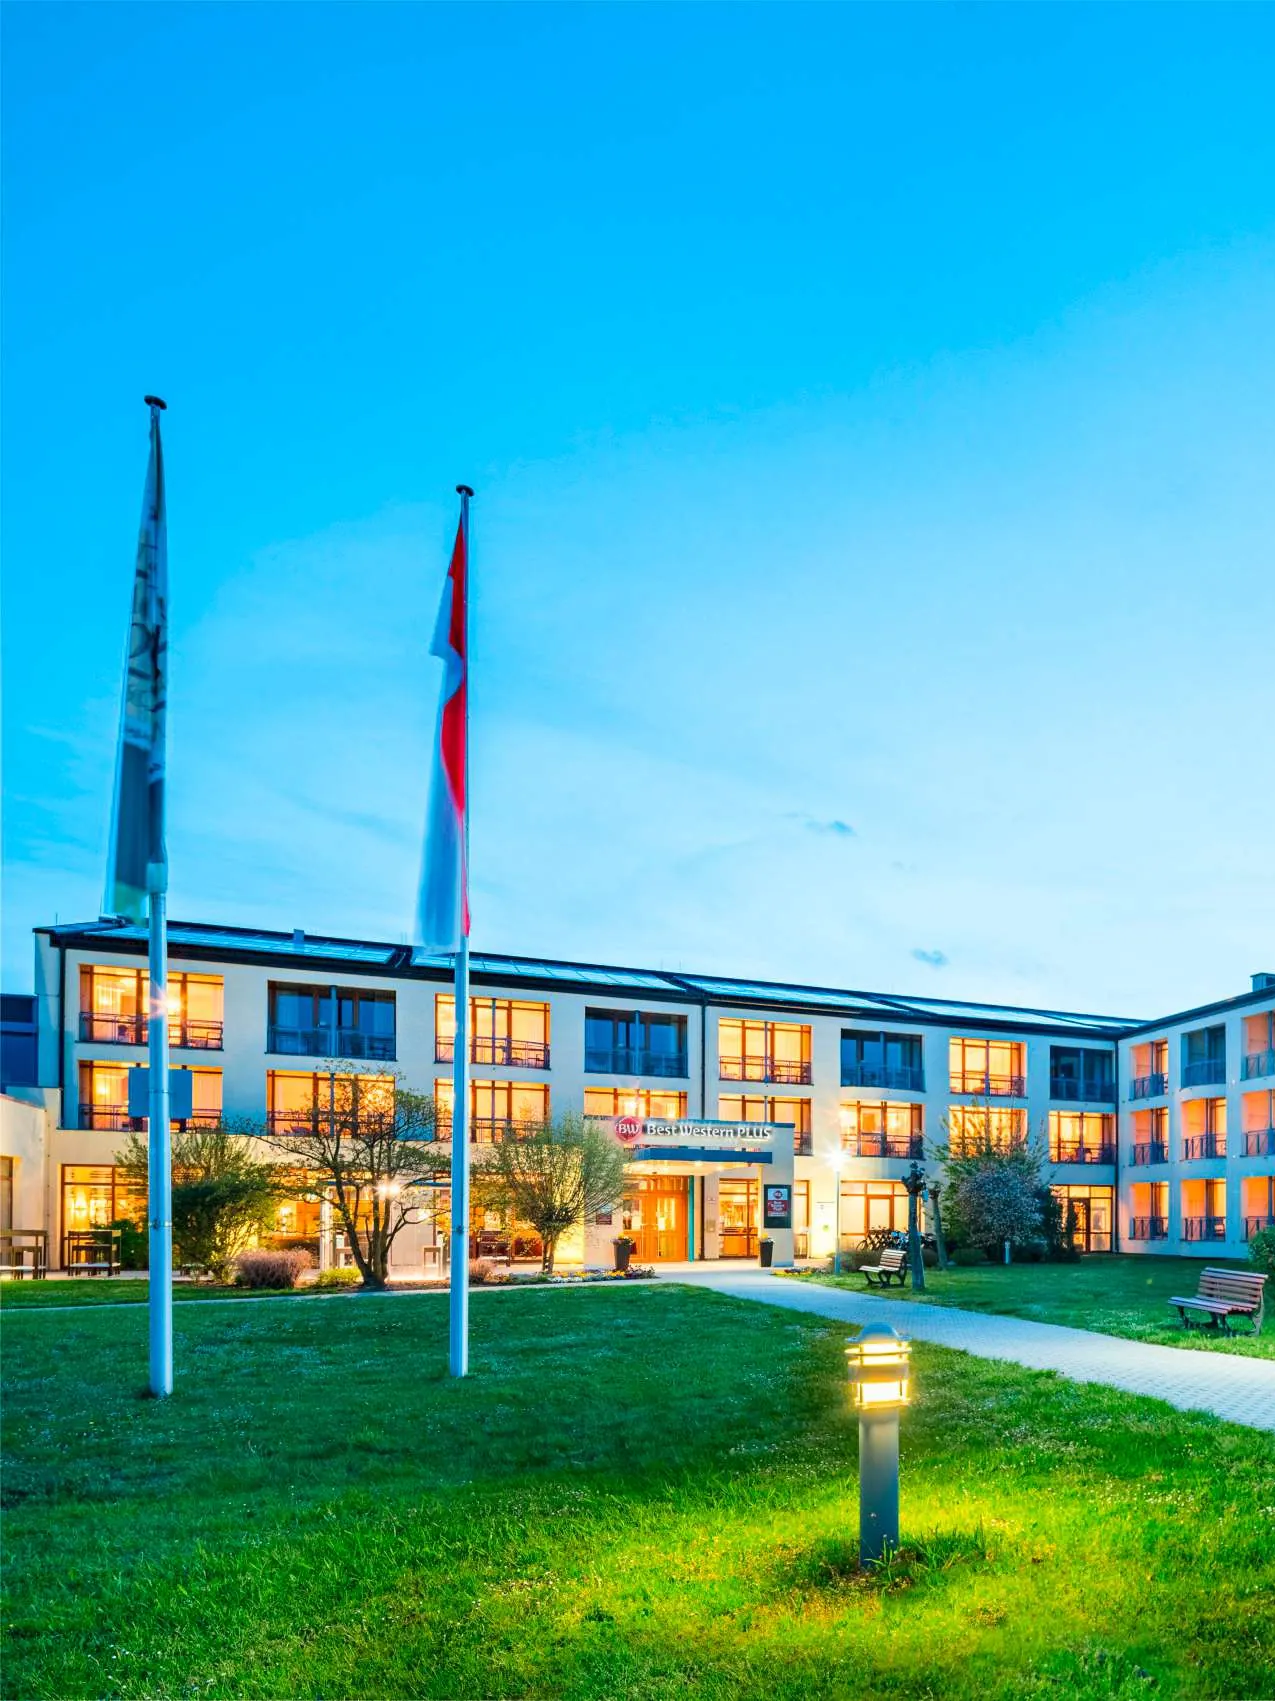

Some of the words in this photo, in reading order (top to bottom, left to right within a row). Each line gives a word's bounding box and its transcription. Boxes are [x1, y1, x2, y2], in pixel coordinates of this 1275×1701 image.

[618, 1123, 640, 1135] BW
[647, 1123, 677, 1136] Best
[679, 1124, 735, 1138] Western
[737, 1127, 772, 1140] PLUS
